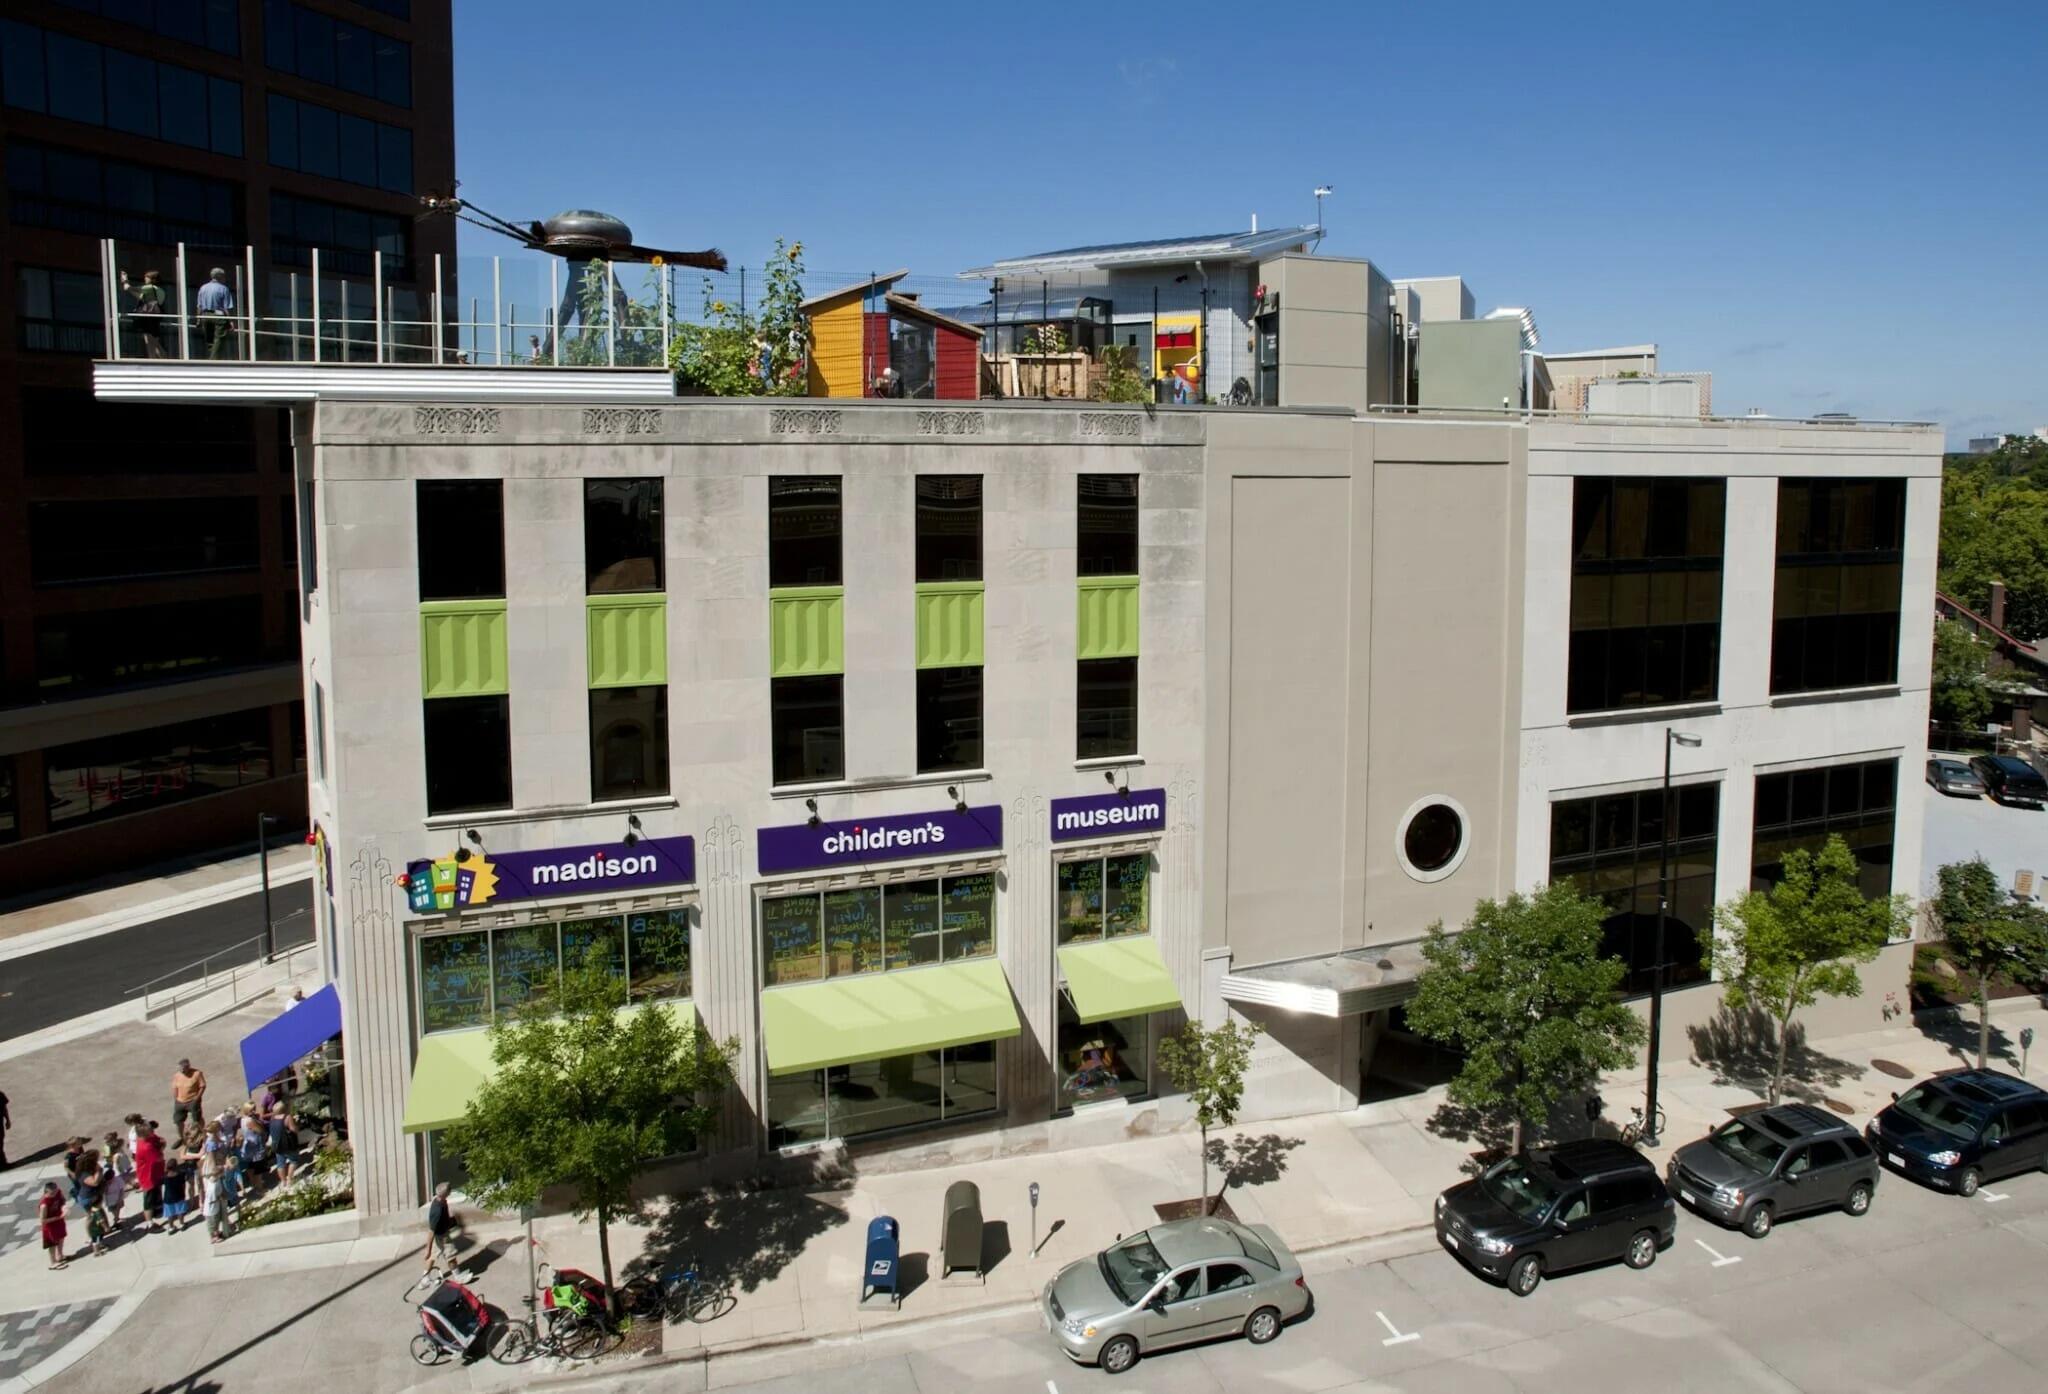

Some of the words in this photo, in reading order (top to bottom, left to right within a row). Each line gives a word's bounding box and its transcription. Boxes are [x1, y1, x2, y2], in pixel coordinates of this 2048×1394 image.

[1057, 803, 1159, 830] museum
[822, 821, 945, 854] children's
[532, 853, 657, 884] madison
